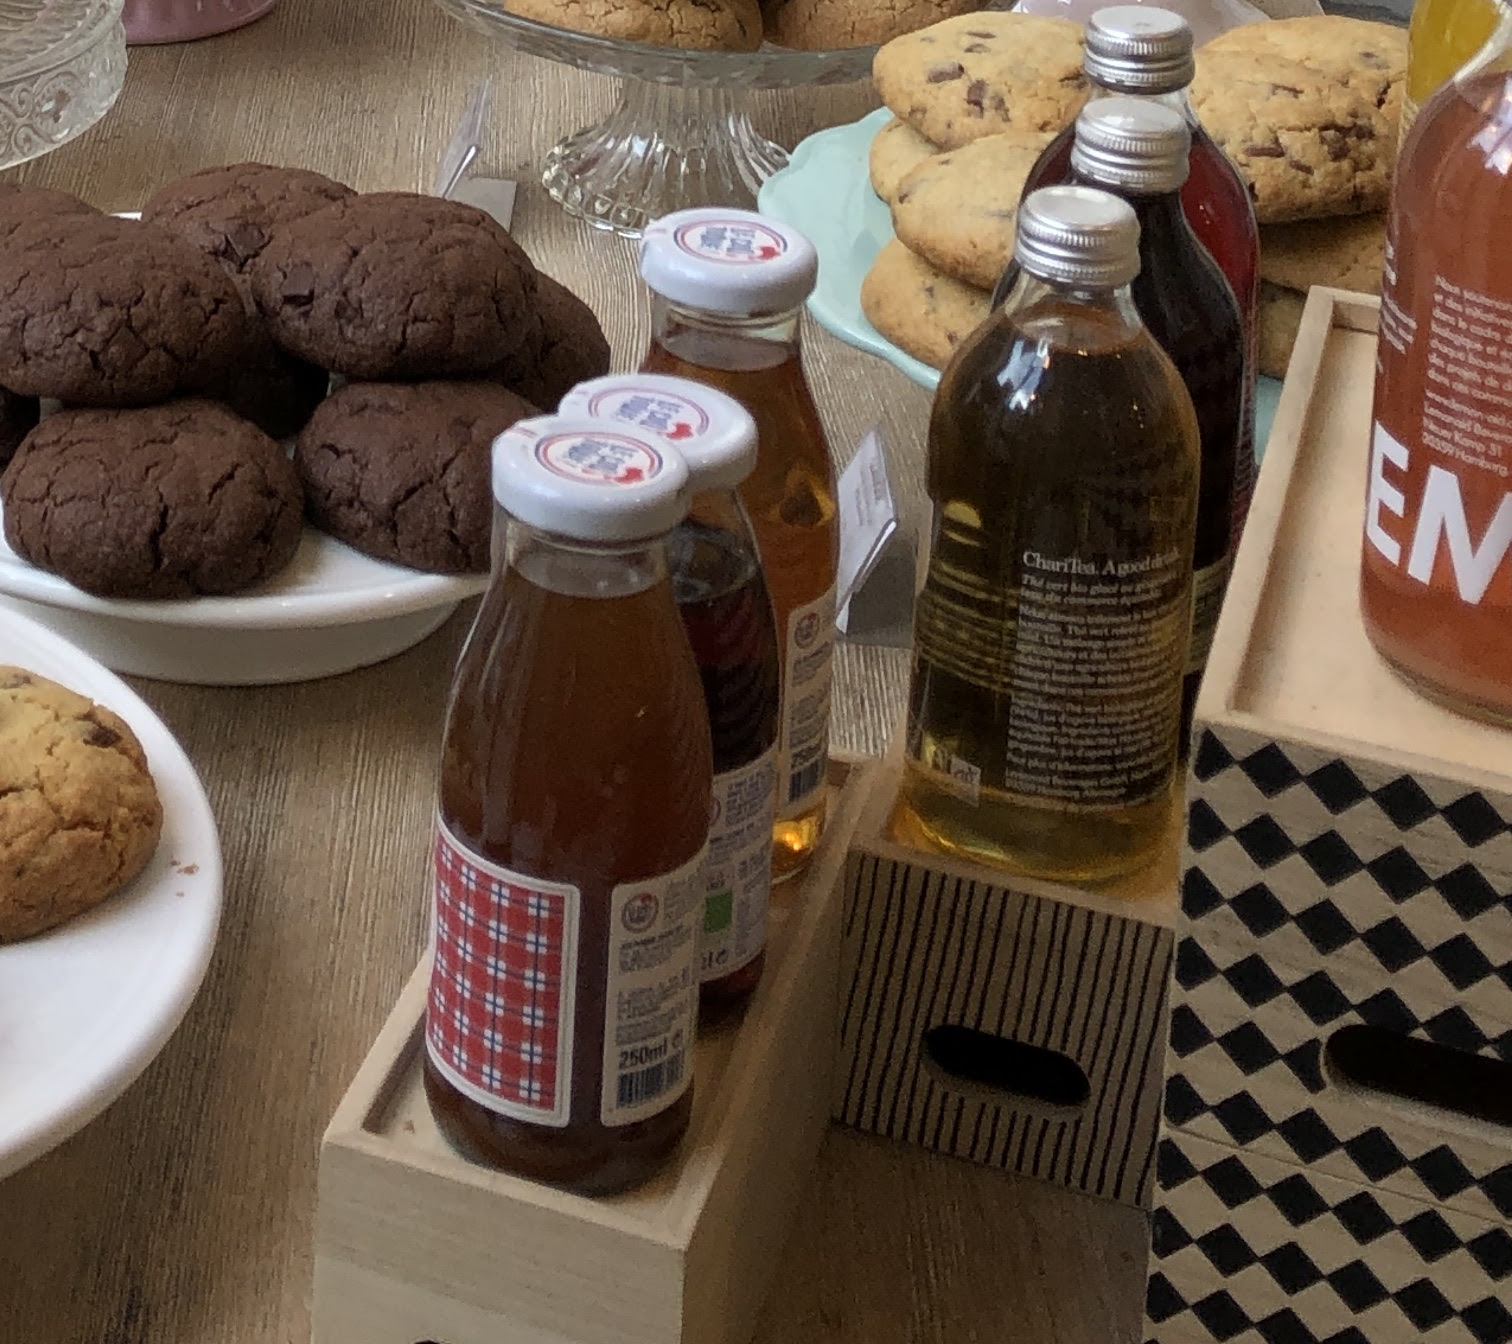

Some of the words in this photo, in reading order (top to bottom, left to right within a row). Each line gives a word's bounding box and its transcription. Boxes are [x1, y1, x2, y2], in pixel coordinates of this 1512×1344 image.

[1454, 450, 1509, 478] Hamburg
[1102, 559, 1116, 575] A
[1117, 554, 1150, 578] good
[619, 1038, 668, 1070] 250ml
